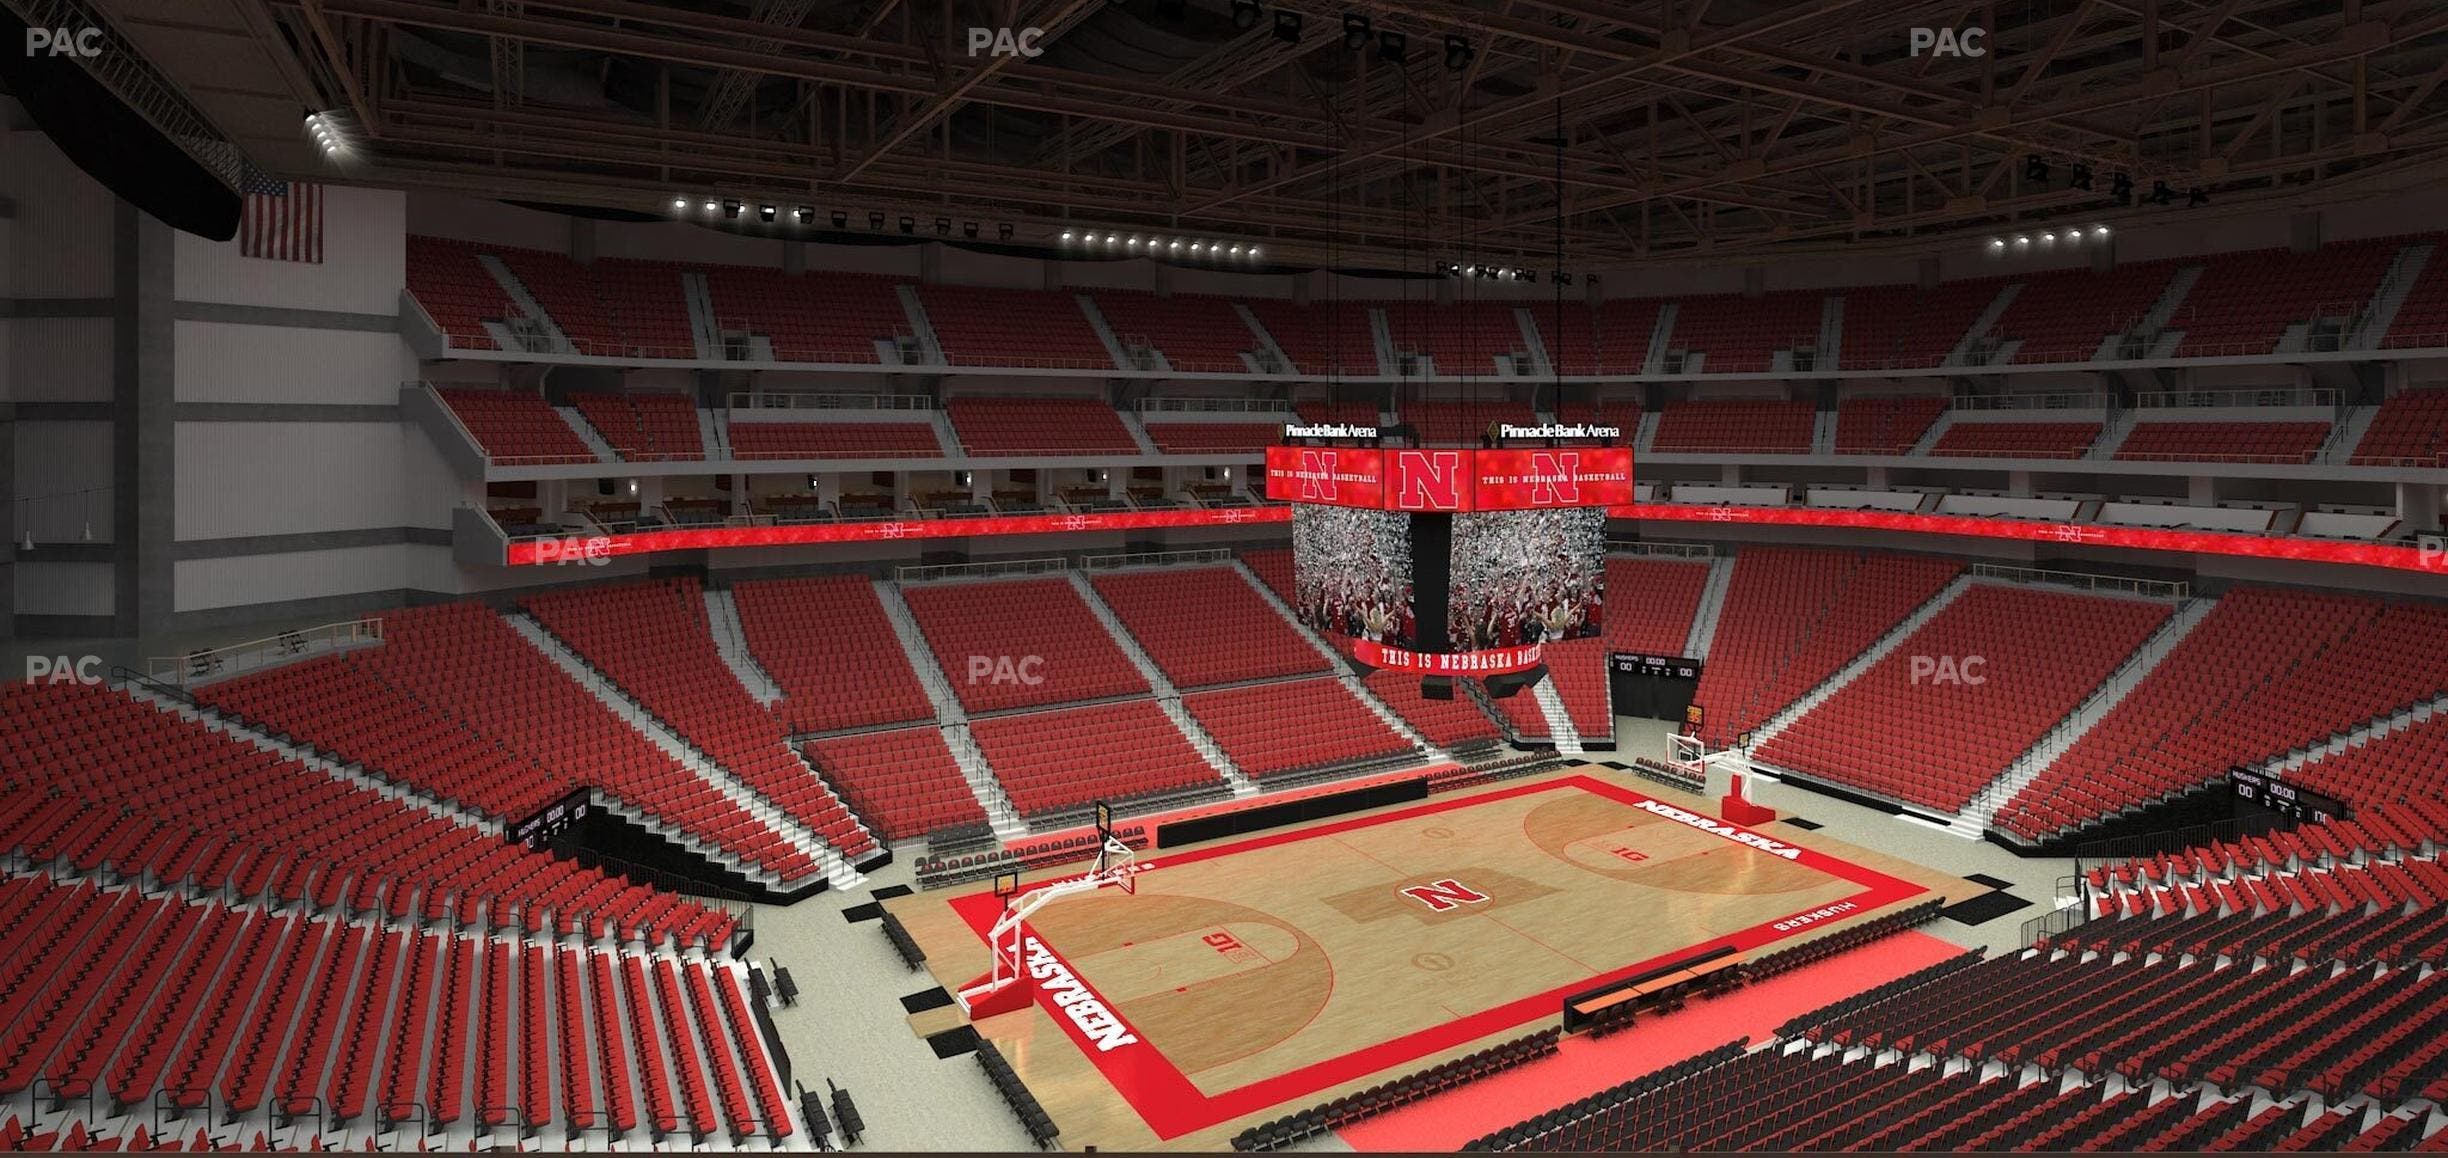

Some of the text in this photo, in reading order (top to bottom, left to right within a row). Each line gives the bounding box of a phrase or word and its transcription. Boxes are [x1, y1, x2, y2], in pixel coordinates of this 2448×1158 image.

[1286, 423, 1377, 438] Pinnacle Bank Arena
[1501, 423, 1620, 438] Pinnacle Bank Arena
[1400, 452, 1458, 509] N
[1481, 476, 1504, 484] THIS
[1508, 476, 1518, 484] IS
[1573, 472, 1626, 482] BASKETBALL
[1381, 648, 1410, 667] THIS
[1418, 652, 1432, 668] IS
[1440, 653, 1512, 670] NEBRASKA
[2238, 784, 2253, 798] 00
[575, 804, 586, 820] 00
[1633, 800, 1802, 860] NEBRASKA
[1400, 878, 1490, 912] N
[1773, 901, 1858, 931] HUSKERS
